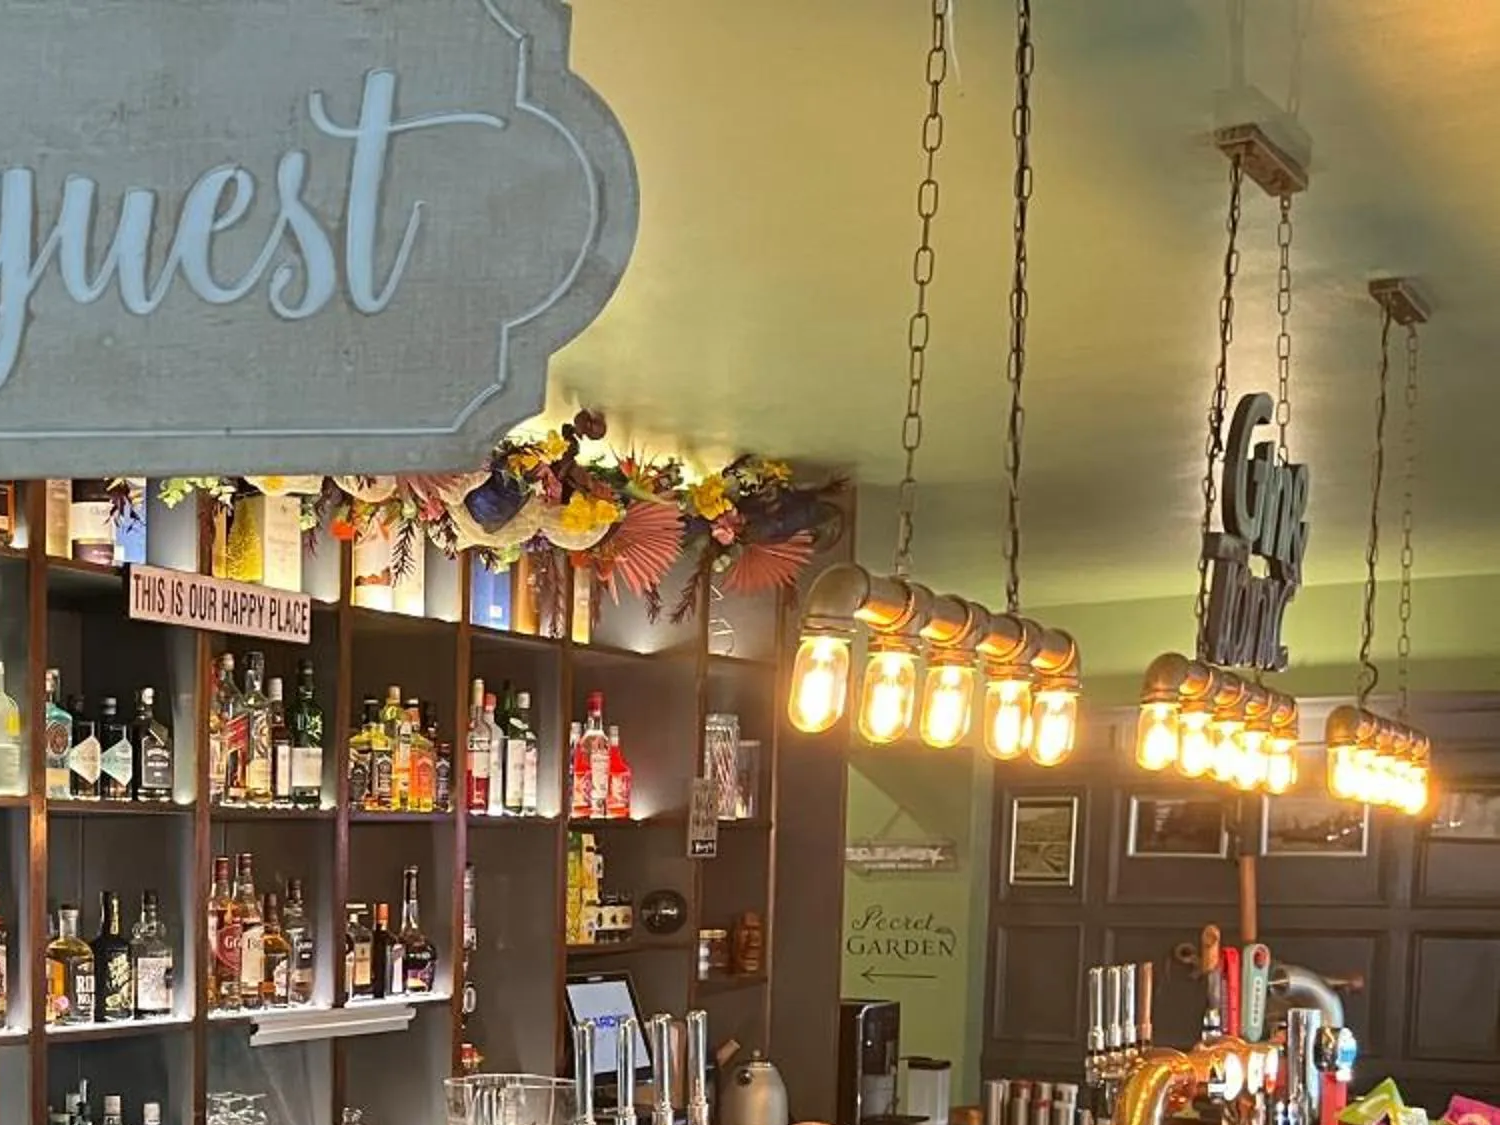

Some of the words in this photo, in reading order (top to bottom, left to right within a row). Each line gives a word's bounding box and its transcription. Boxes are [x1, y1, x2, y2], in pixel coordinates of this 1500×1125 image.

[134, 574, 165, 613] THIS
[171, 579, 184, 616] IS
[189, 584, 217, 622] OUR
[222, 590, 265, 628] HAPPY
[269, 598, 308, 635] PLACE
[852, 905, 935, 931] Secret
[847, 935, 956, 960] GARDEN
